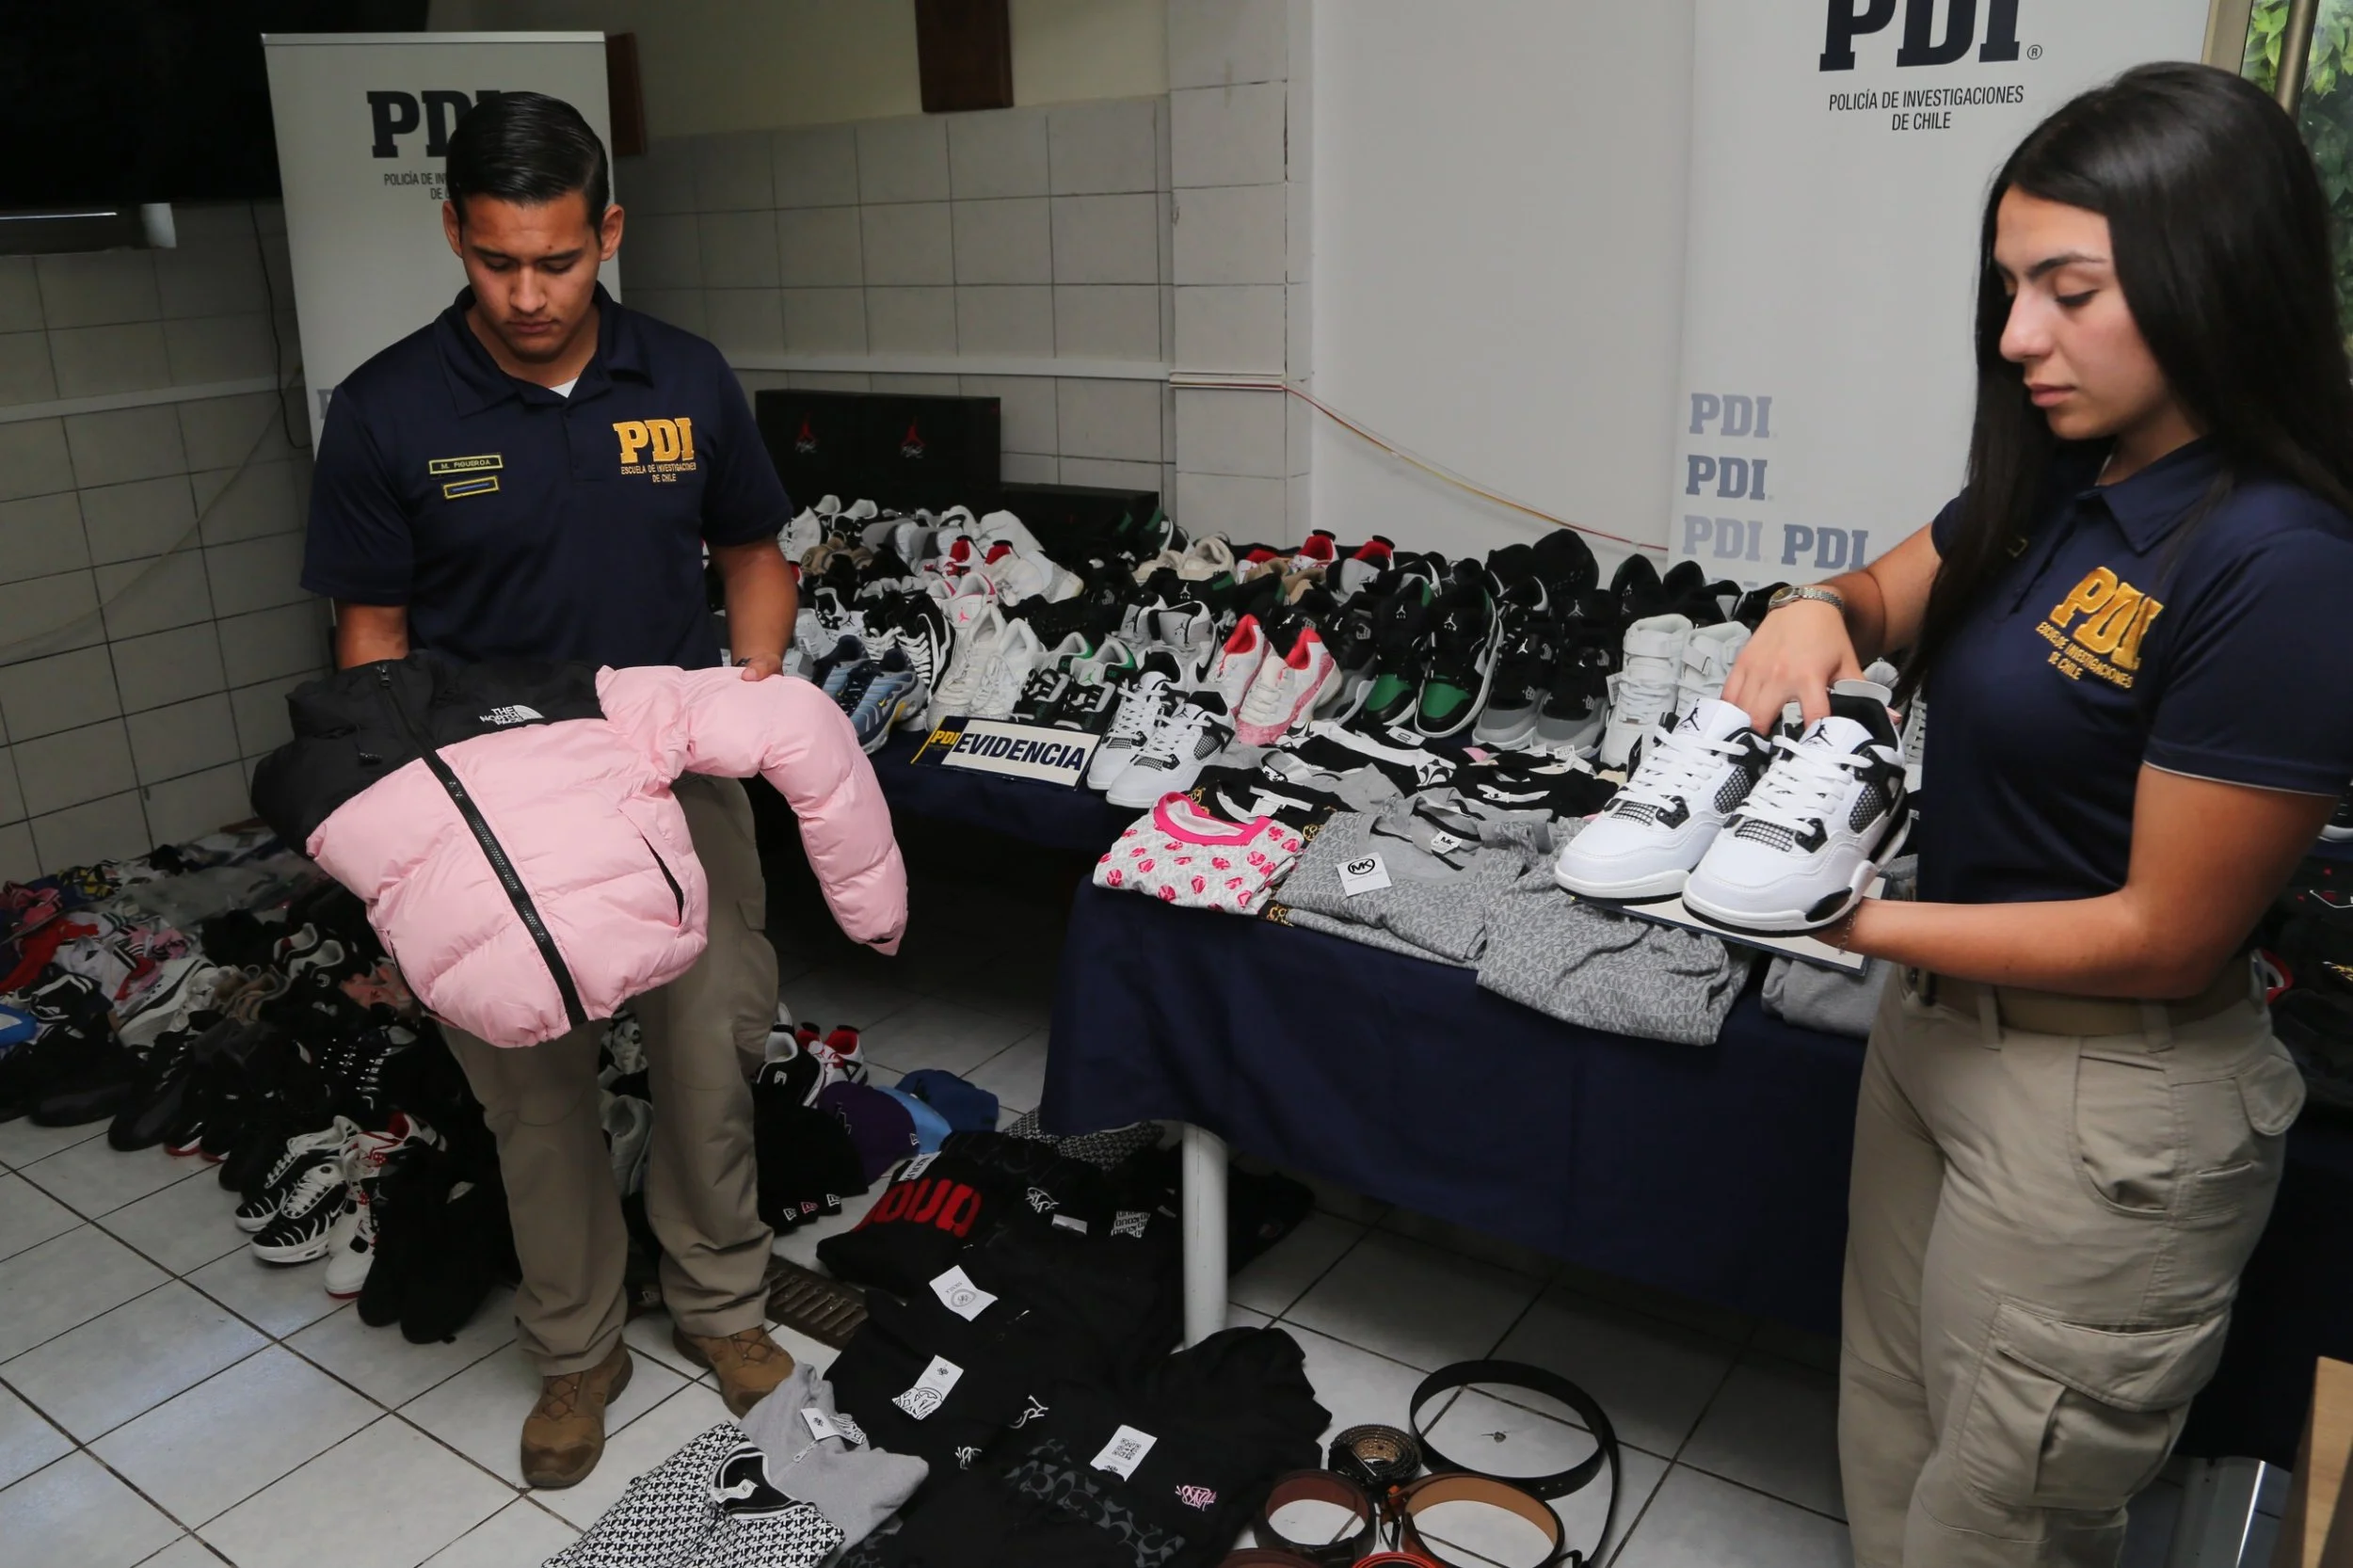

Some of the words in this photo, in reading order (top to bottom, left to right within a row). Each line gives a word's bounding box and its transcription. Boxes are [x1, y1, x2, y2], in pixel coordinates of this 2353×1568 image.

[1819, 0, 2021, 72] PDI
[1829, 88, 1878, 111] POLICÍA
[1882, 91, 1898, 108] DE
[1903, 86, 2024, 108] INVESTIGACIONES
[366, 89, 502, 158] PD
[1892, 113, 1909, 131] DE
[1913, 112, 1951, 130] CHILE
[384, 170, 420, 185] POLICÍA
[421, 172, 433, 185] DE
[430, 187, 442, 200] DE
[1689, 392, 1772, 439] PDI
[613, 417, 695, 464] PDI
[454, 458, 491, 469] FIGUEROA
[621, 465, 647, 474] ESCUELA
[648, 464, 656, 472] DE
[651, 474, 661, 483] DE
[662, 473, 677, 482] CHILE
[1686, 454, 1768, 501] PDI
[1682, 515, 1764, 562] PDI
[1781, 523, 1869, 570] PDI
[2049, 566, 2164, 672] PDI
[490, 706, 514, 715] THE
[930, 729, 961, 744] PDI
[952, 732, 1086, 771] EVIDENCIA
